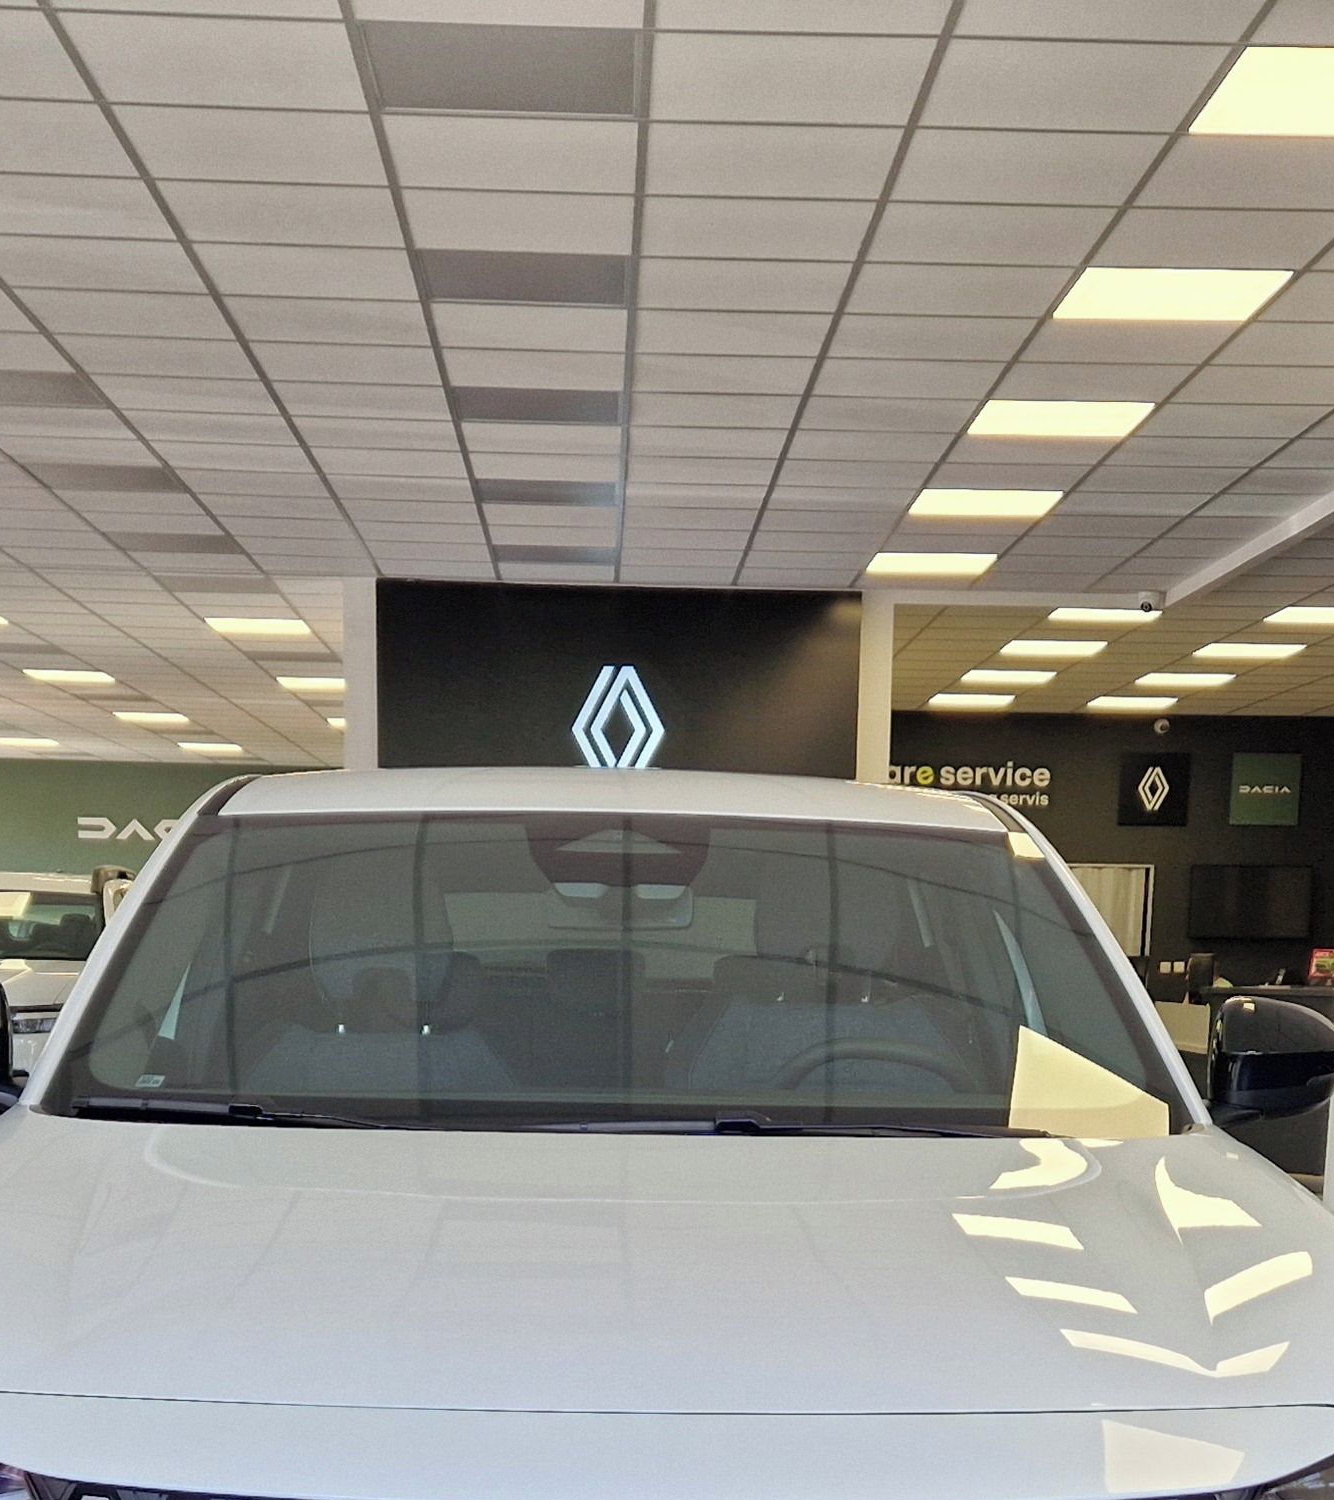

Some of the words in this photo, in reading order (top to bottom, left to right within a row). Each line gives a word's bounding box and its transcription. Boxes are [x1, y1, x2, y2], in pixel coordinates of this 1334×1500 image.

[939, 761, 1051, 787] service
[1239, 785, 1291, 794] DACIA
[1001, 792, 1049, 806] servis
